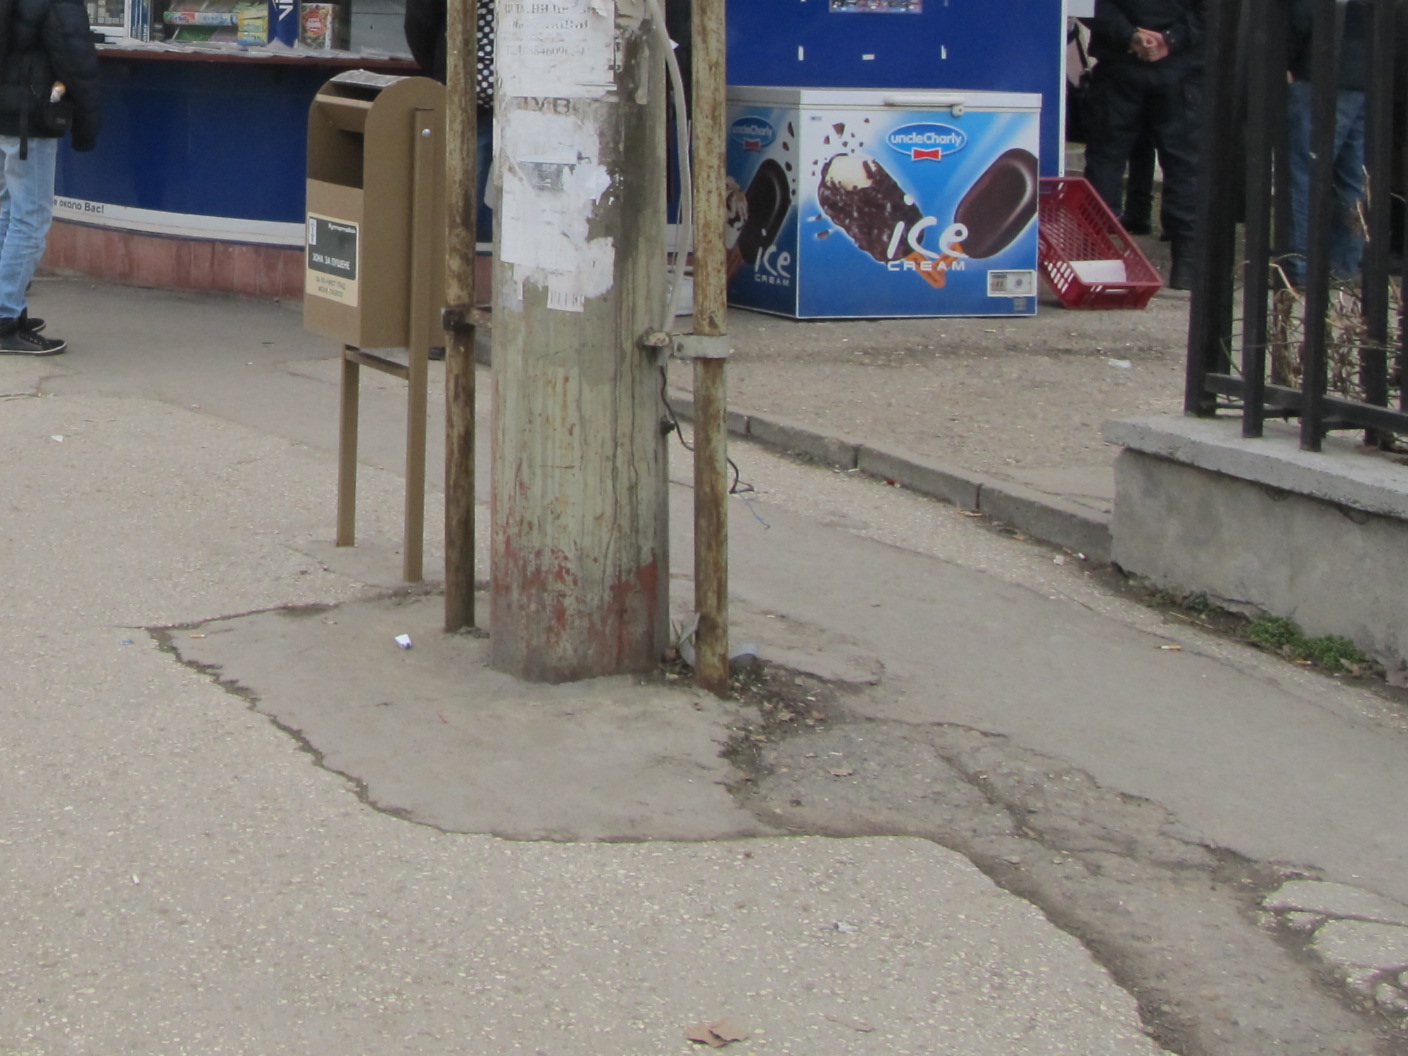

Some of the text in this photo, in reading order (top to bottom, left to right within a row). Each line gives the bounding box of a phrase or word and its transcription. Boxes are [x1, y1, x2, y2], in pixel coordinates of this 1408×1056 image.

[890, 132, 962, 147] uncleCharly
[59, 200, 82, 210] около
[84, 202, 105, 214] Вас!
[887, 261, 966, 272] CREAM
